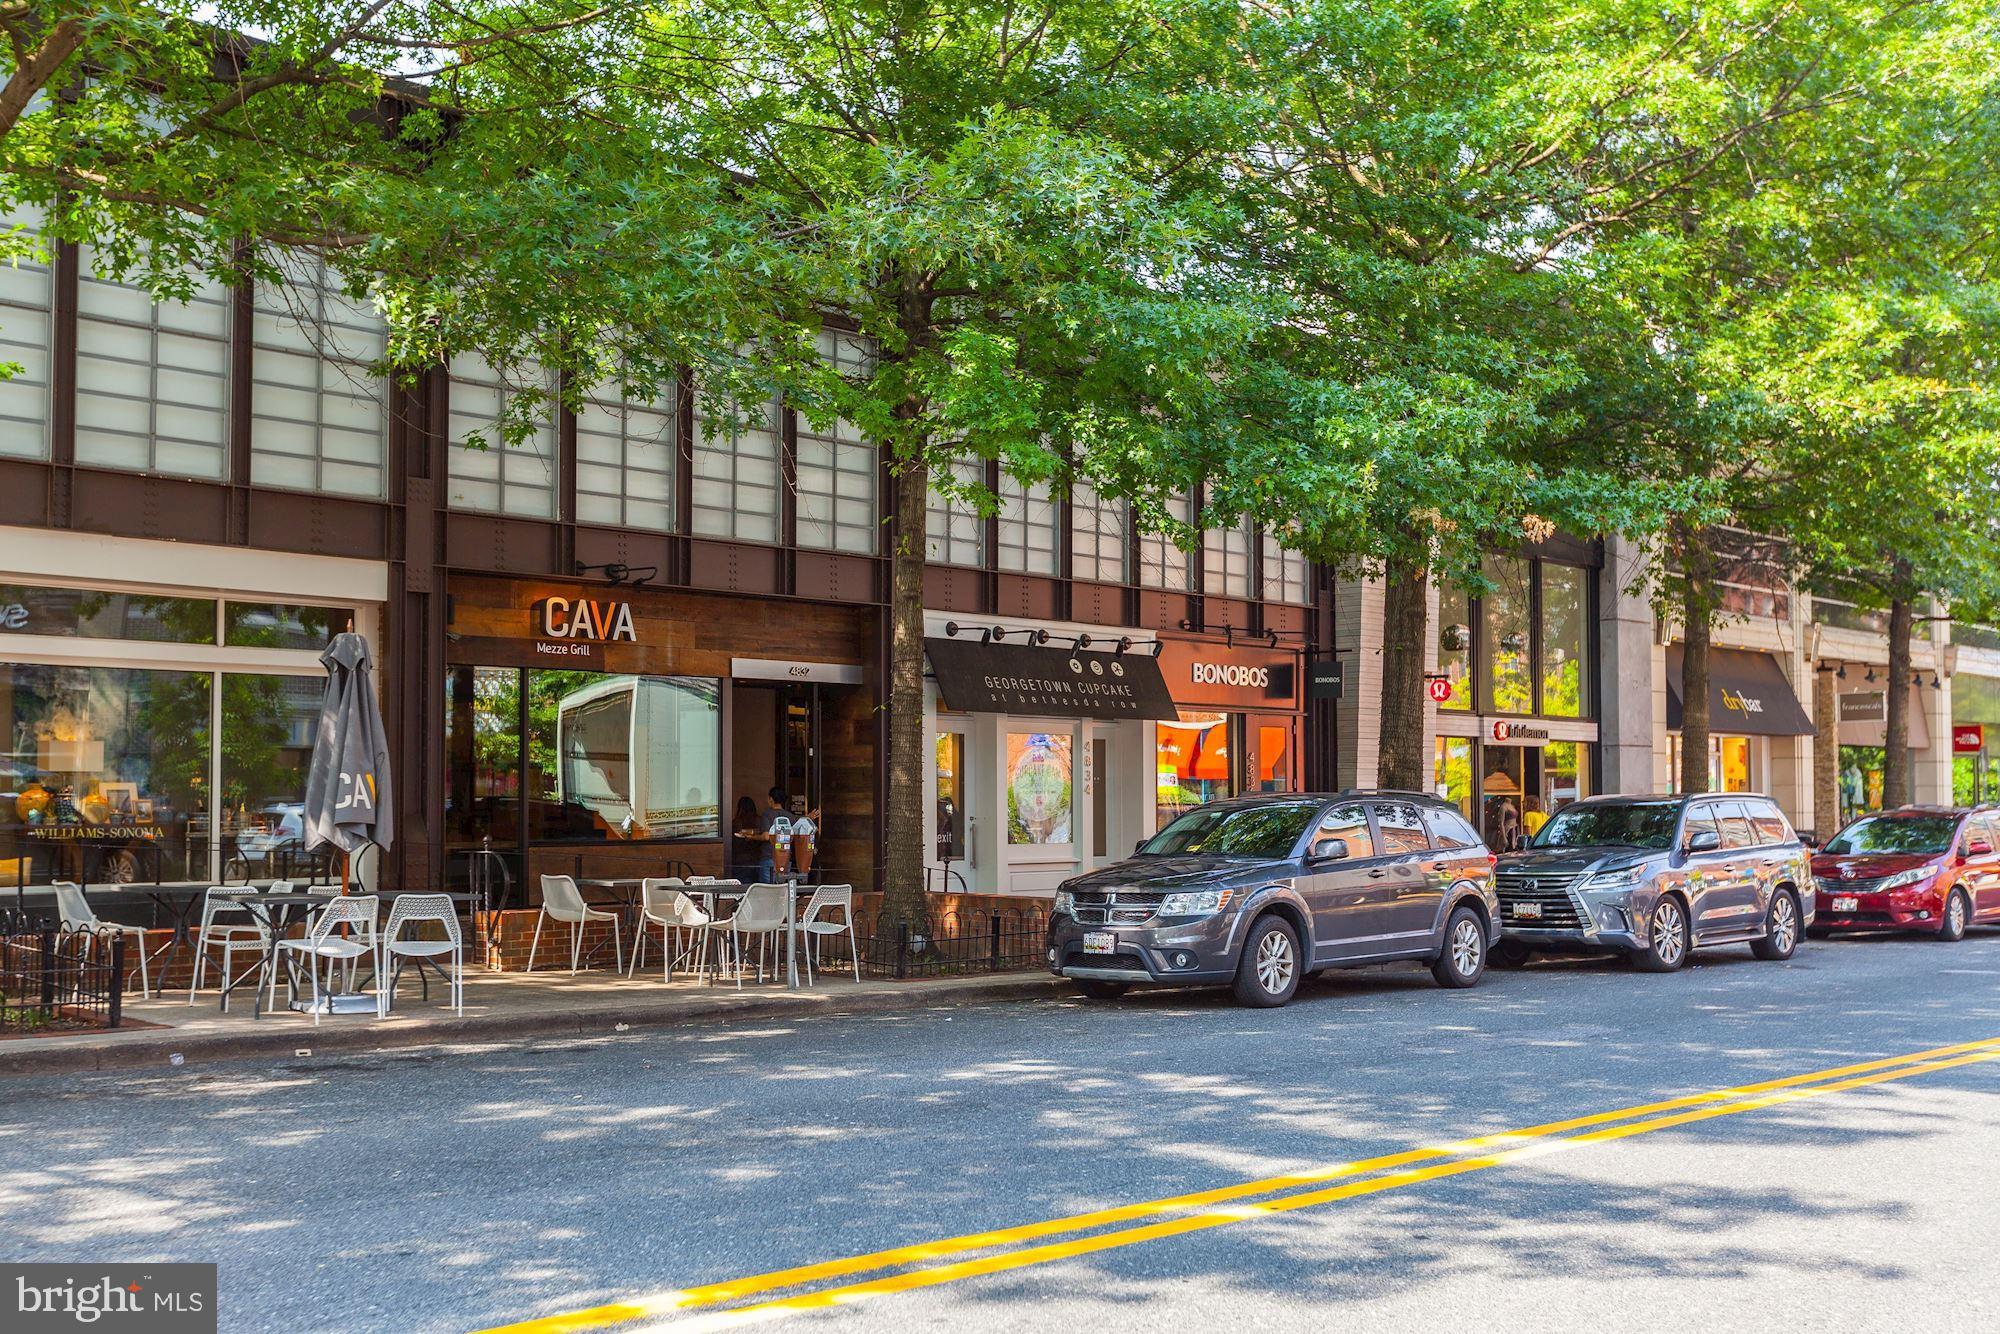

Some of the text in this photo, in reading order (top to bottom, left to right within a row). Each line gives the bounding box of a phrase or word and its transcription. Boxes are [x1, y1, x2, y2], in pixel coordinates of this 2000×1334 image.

[545, 596, 637, 642] CAVA
[536, 642, 591, 656] Mezze Grill
[1193, 662, 1269, 688] BONOBOS
[1314, 676, 1340, 684] BONOBOS
[984, 675, 1133, 697] GEORGETOWN CUPCAKE
[990, 693, 1137, 709] at bethesda row
[1721, 688, 1764, 720] drybar
[34, 826, 165, 840] WILLIAMS-SONOMA
[936, 831, 953, 844] exit
